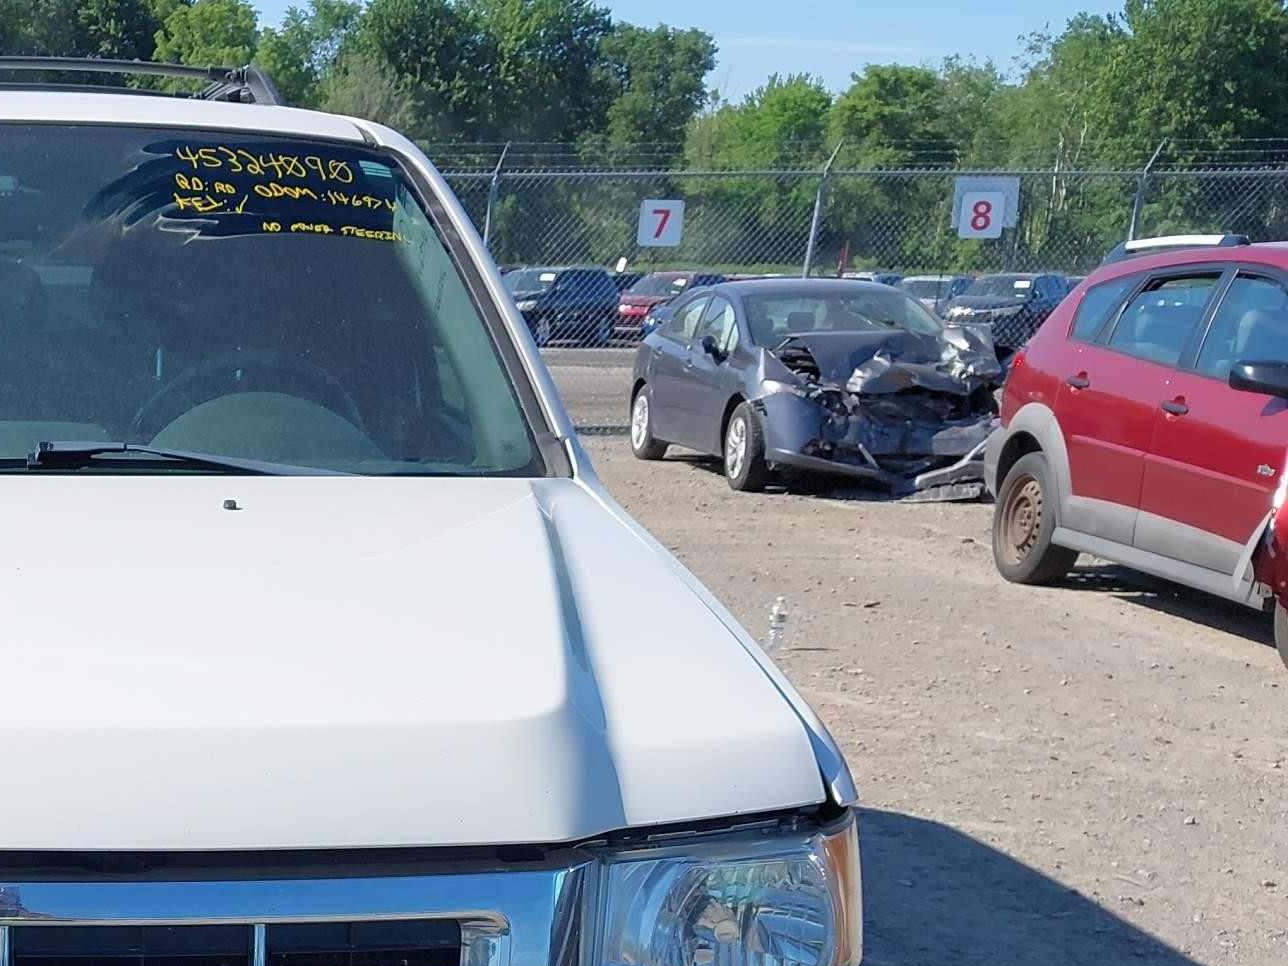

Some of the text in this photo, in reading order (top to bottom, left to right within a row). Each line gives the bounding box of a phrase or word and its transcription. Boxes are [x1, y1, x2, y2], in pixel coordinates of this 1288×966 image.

[176, 146, 353, 183] 45324090
[262, 221, 282, 232] NO
[652, 208, 672, 239] 7
[970, 200, 993, 231] 8
